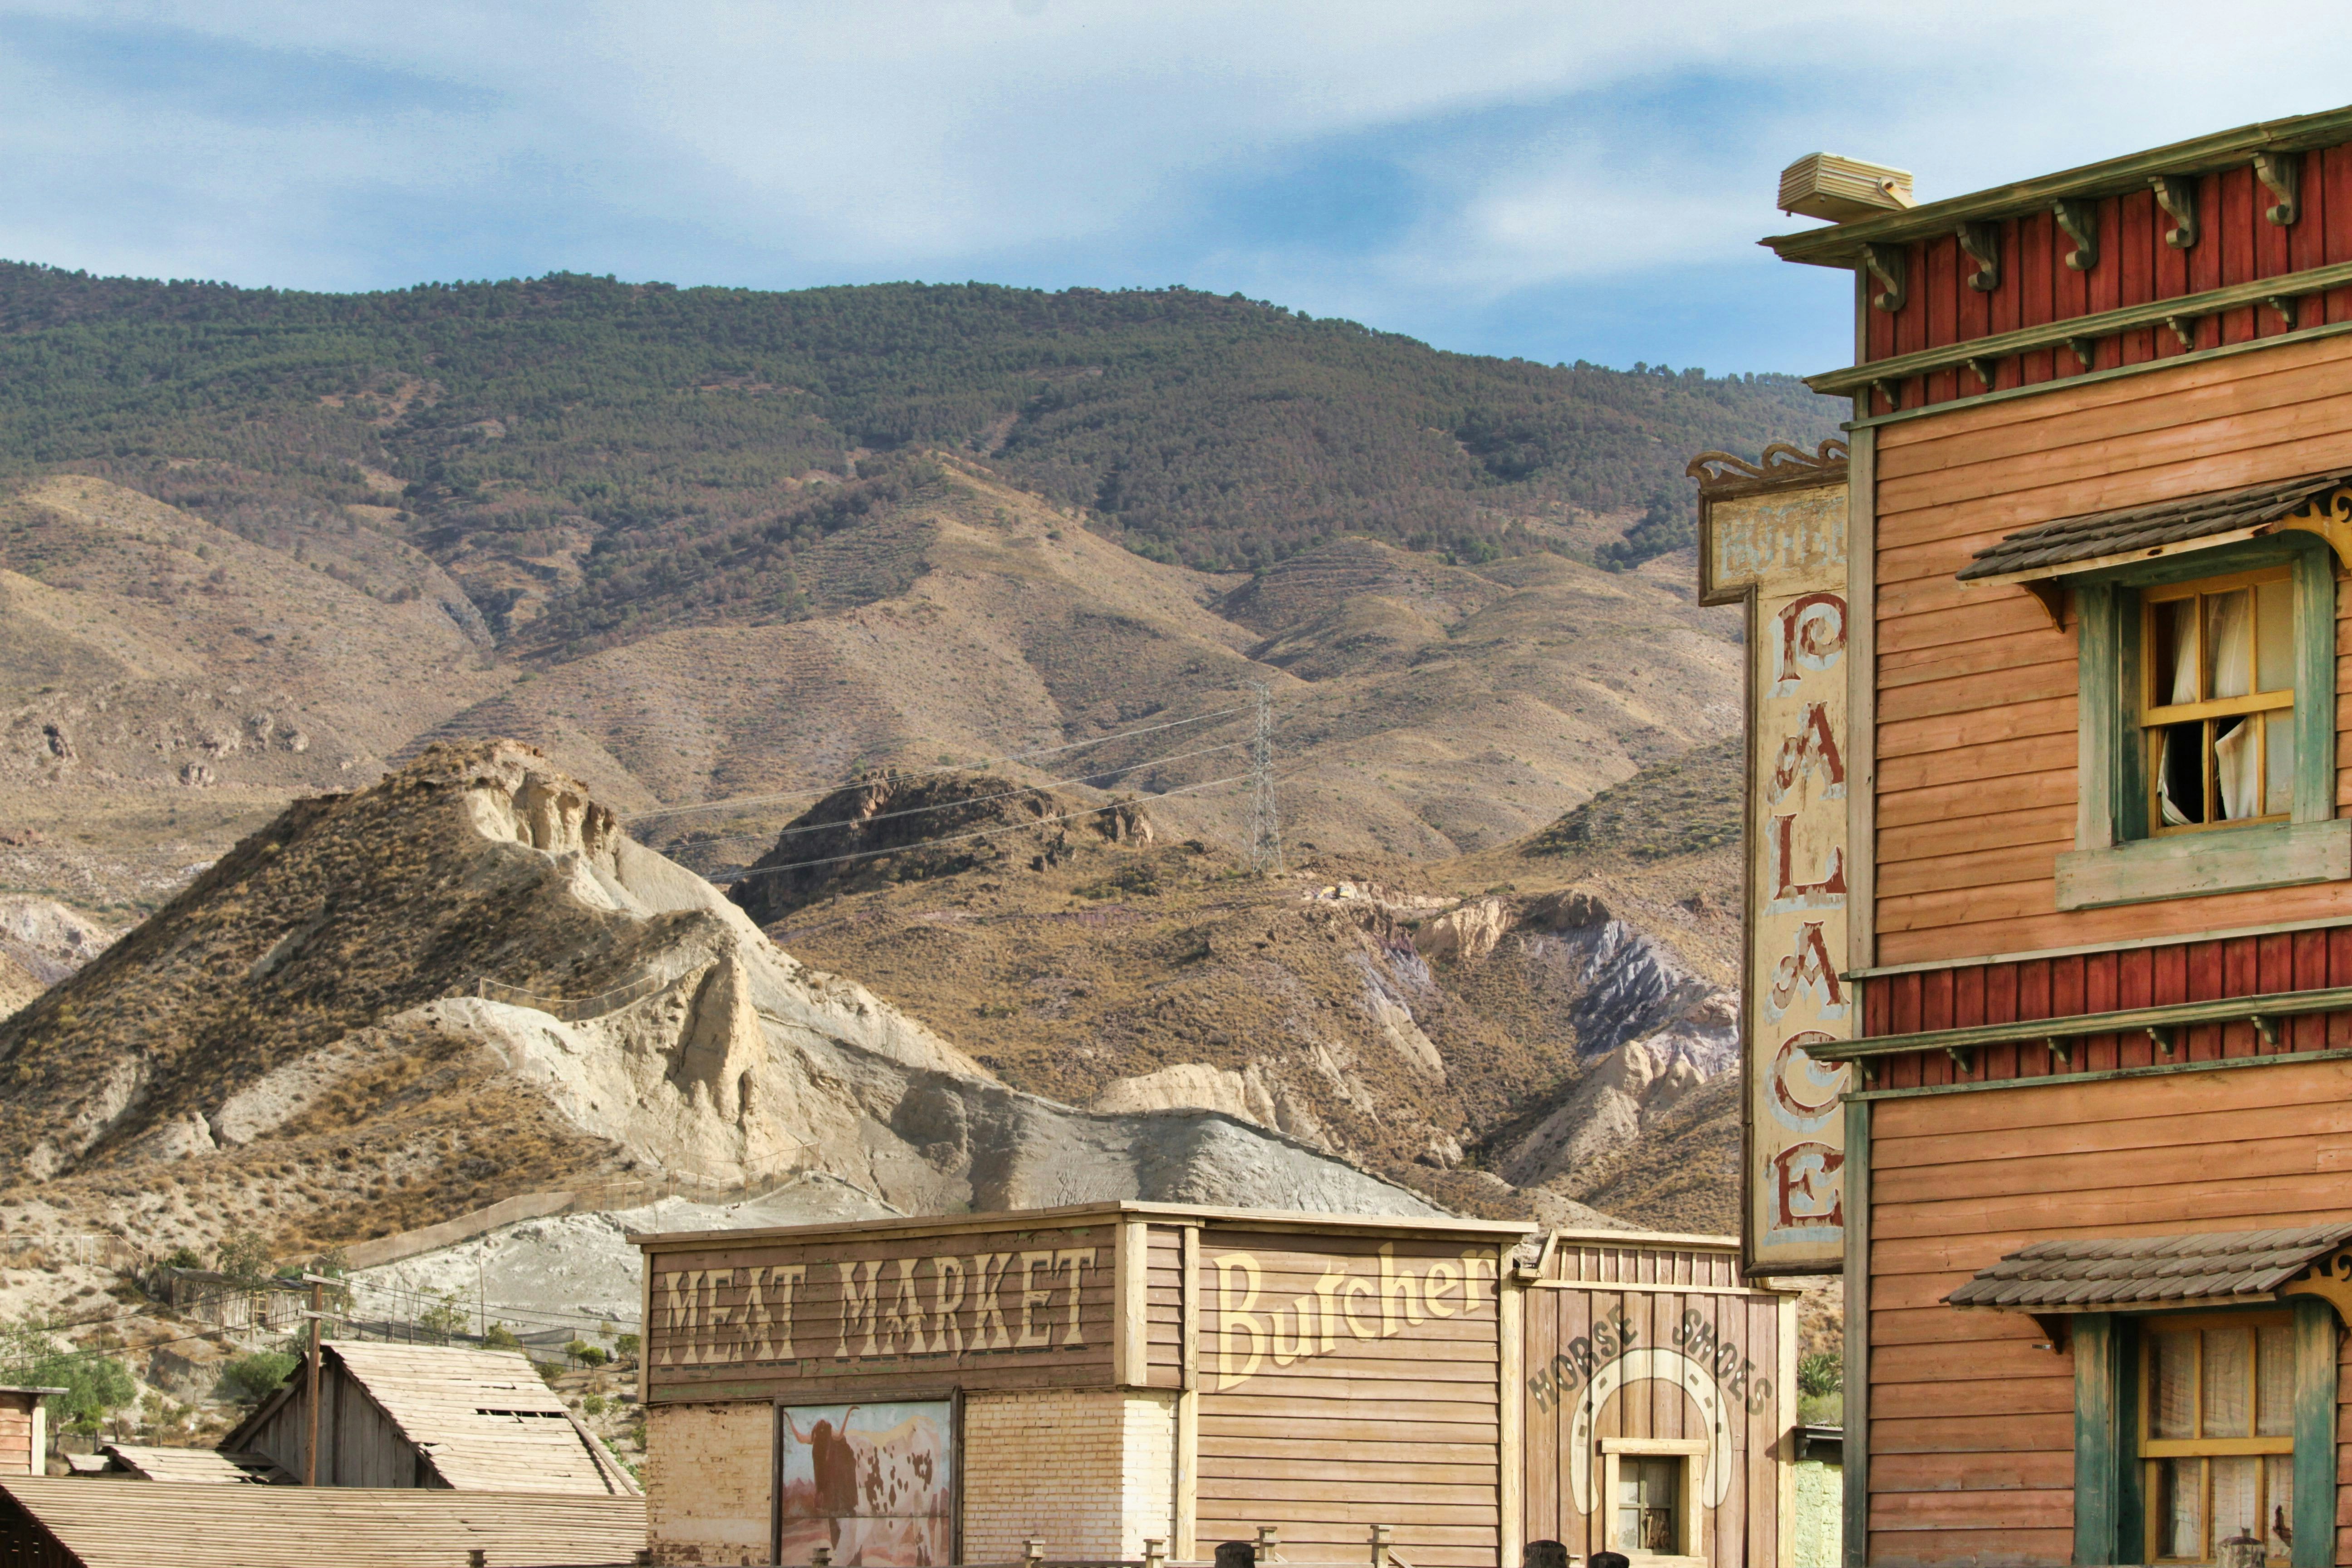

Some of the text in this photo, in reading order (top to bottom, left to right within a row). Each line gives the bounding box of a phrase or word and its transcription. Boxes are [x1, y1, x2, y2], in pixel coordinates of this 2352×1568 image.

[1764, 592, 1850, 1246] PALACE
[659, 1247, 1098, 1366] MEAT MARKET
[1212, 1241, 1498, 1393] Butcher
[1527, 1303, 1773, 1416] HORSE SHOES
